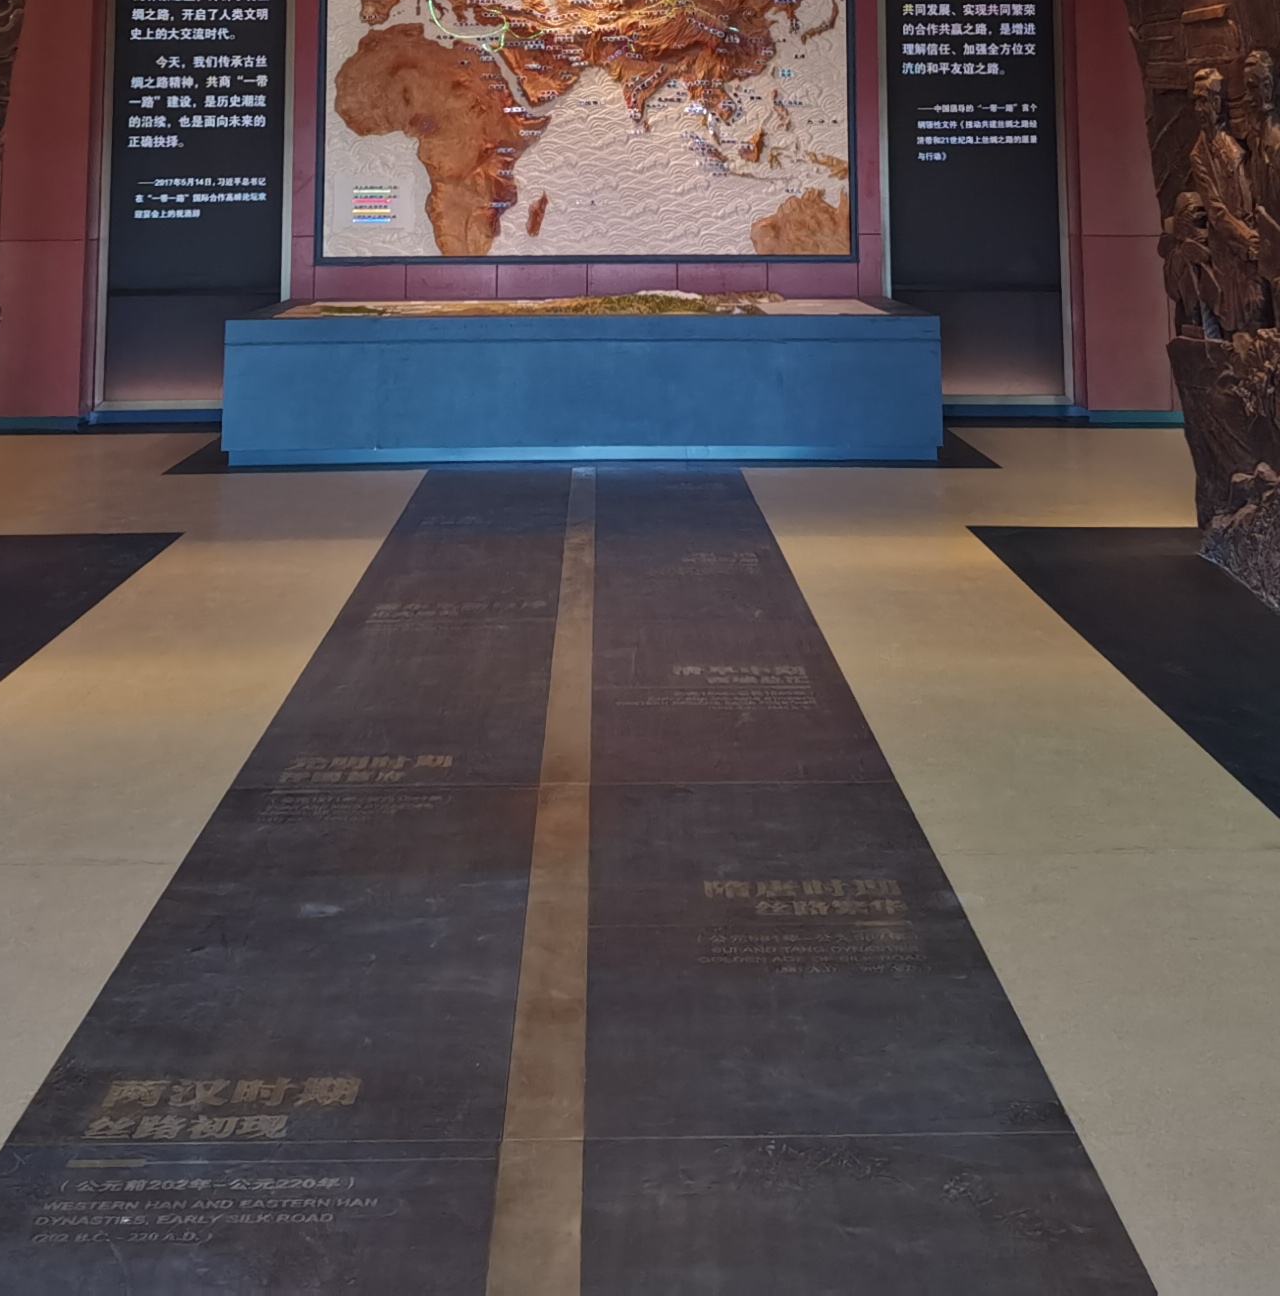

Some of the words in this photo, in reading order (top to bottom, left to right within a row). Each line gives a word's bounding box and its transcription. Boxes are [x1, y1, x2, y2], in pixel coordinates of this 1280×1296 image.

[131, 8, 269, 22] 绸之路，开启了人类文明
[902, 4, 1036, 17] 共同发展、实现共同繁荣
[130, 27, 236, 41] 史上的大交流时代。
[902, 23, 1036, 36] 的合作共赢之路，是增进
[901, 43, 1036, 56] 理解信任、加强全方位交
[156, 55, 268, 69] 今天，我们传承古丝
[901, 62, 1005, 76] 流的和平友谊之路。
[101, 1076, 363, 1108] 两汉时期
[81, 1114, 290, 1140] 丝路初现
[43, 1199, 140, 1212] WESTERN
[144, 1198, 189, 1211] HAN
[191, 1198, 236, 1210] AND
[238, 1197, 333, 1210] EASTERN
[336, 1197, 379, 1209] HAN
[155, 1213, 222, 1226] EARLY
[226, 1213, 273, 1225] SILK
[275, 1212, 335, 1224] ROAD
